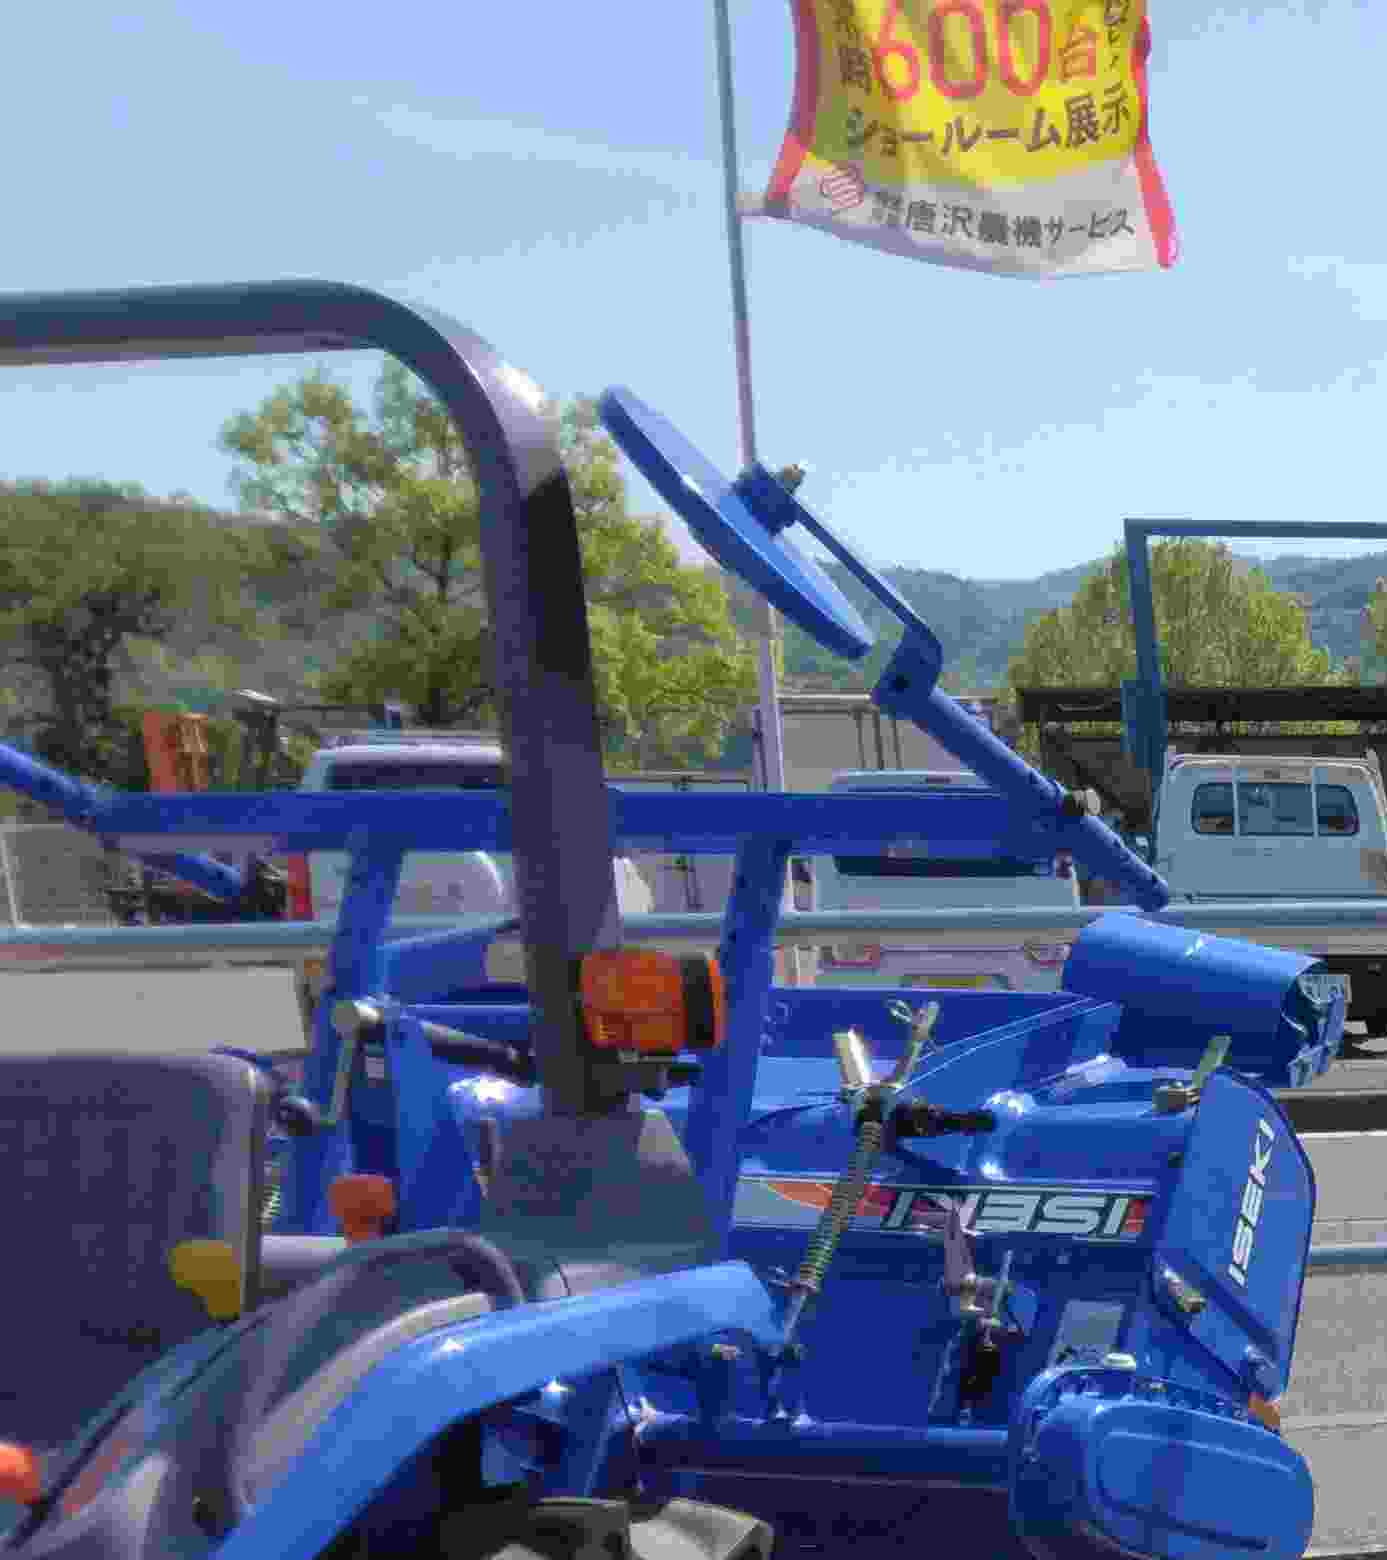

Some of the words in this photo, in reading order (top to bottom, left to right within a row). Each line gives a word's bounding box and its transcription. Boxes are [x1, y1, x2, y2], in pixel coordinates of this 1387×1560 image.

[845, 82, 1131, 157] ショールーム展示
[1226, 1118, 1276, 1289] ISEKI
